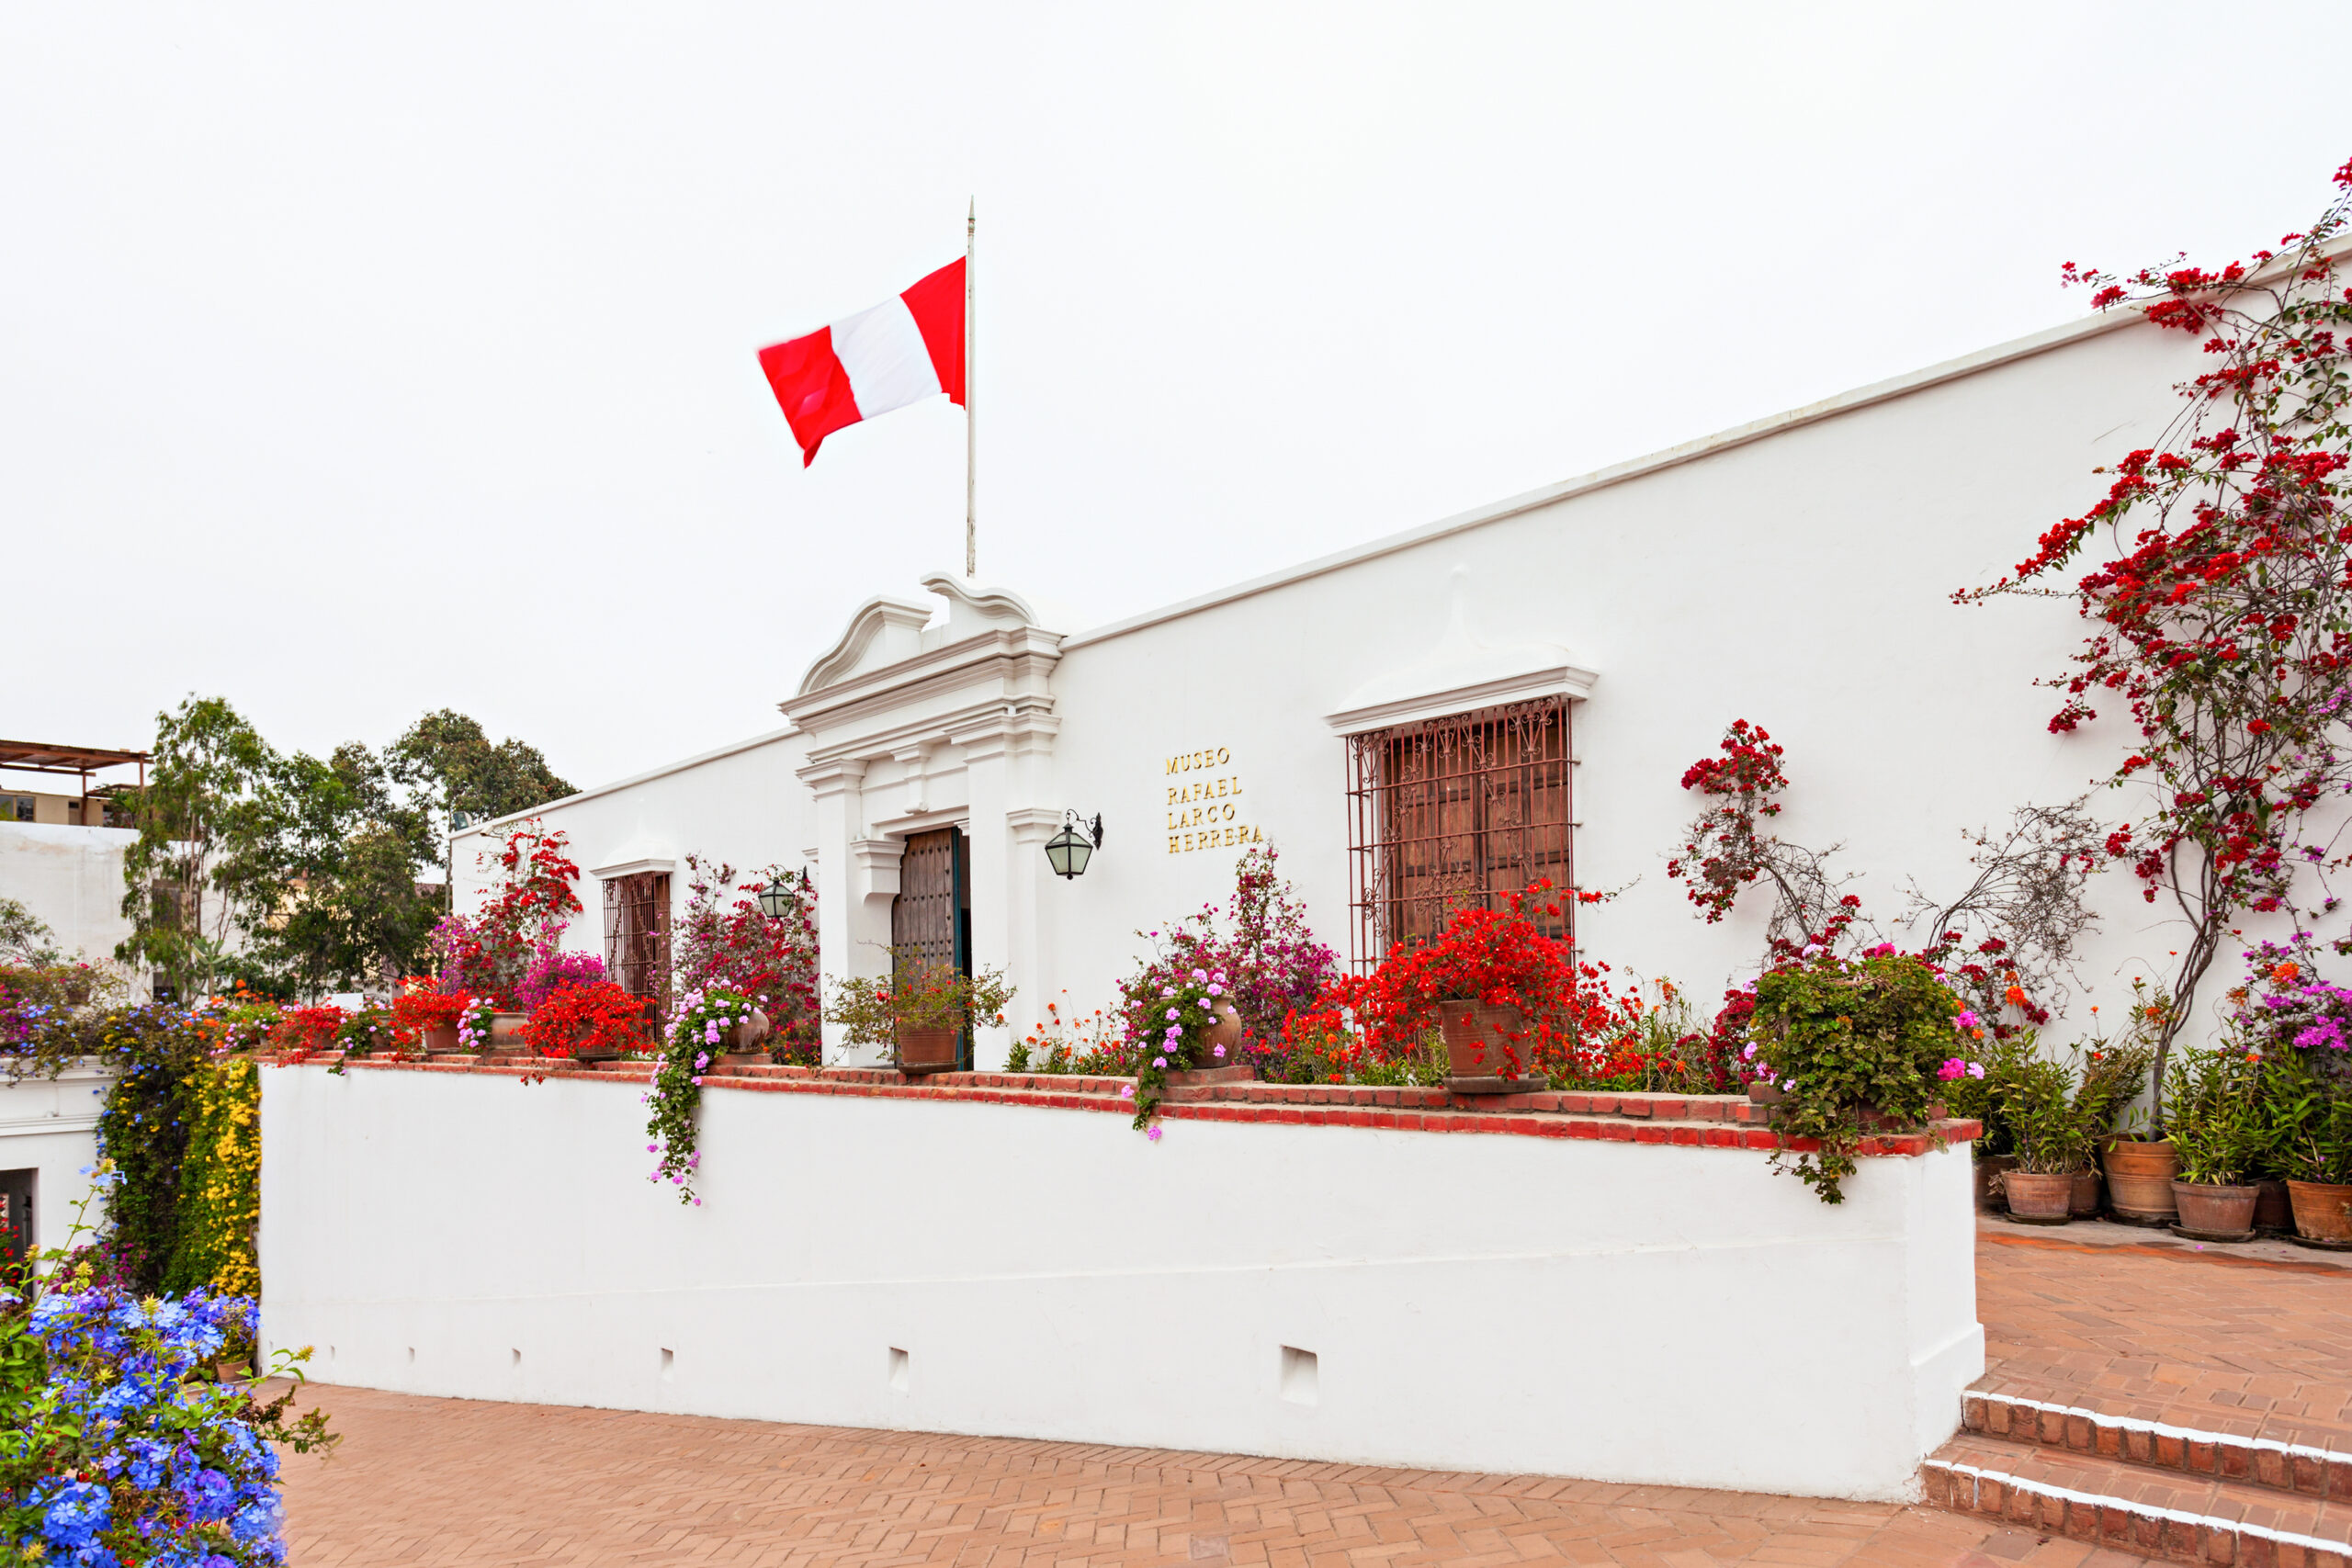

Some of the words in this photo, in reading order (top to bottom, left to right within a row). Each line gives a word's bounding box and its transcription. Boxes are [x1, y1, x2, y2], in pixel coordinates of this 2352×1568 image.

[1166, 747, 1230, 775] MUSEO
[1168, 776, 1242, 806] RAFAEL
[1168, 803, 1235, 830] LARCO
[1169, 824, 1264, 854] HERRERA
